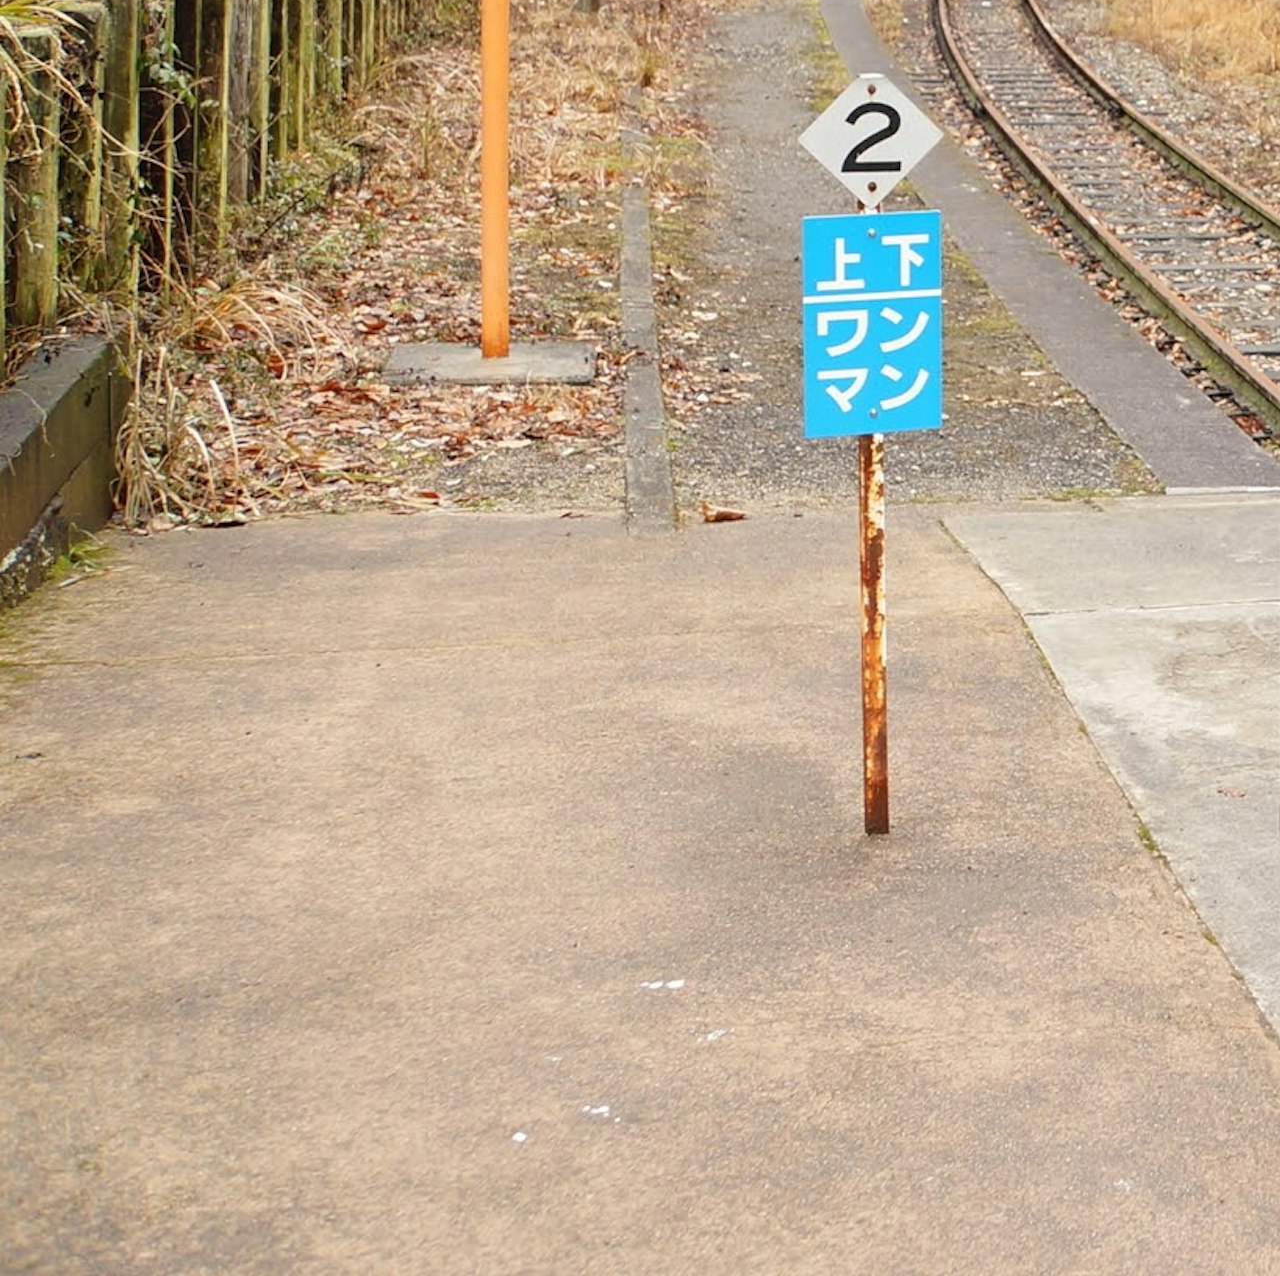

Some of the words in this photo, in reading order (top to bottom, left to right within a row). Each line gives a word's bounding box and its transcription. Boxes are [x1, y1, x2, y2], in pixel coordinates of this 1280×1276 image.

[841, 103, 902, 174] 2
[817, 233, 930, 292] 上下
[816, 304, 929, 358] ワン
[816, 364, 930, 413] マン
